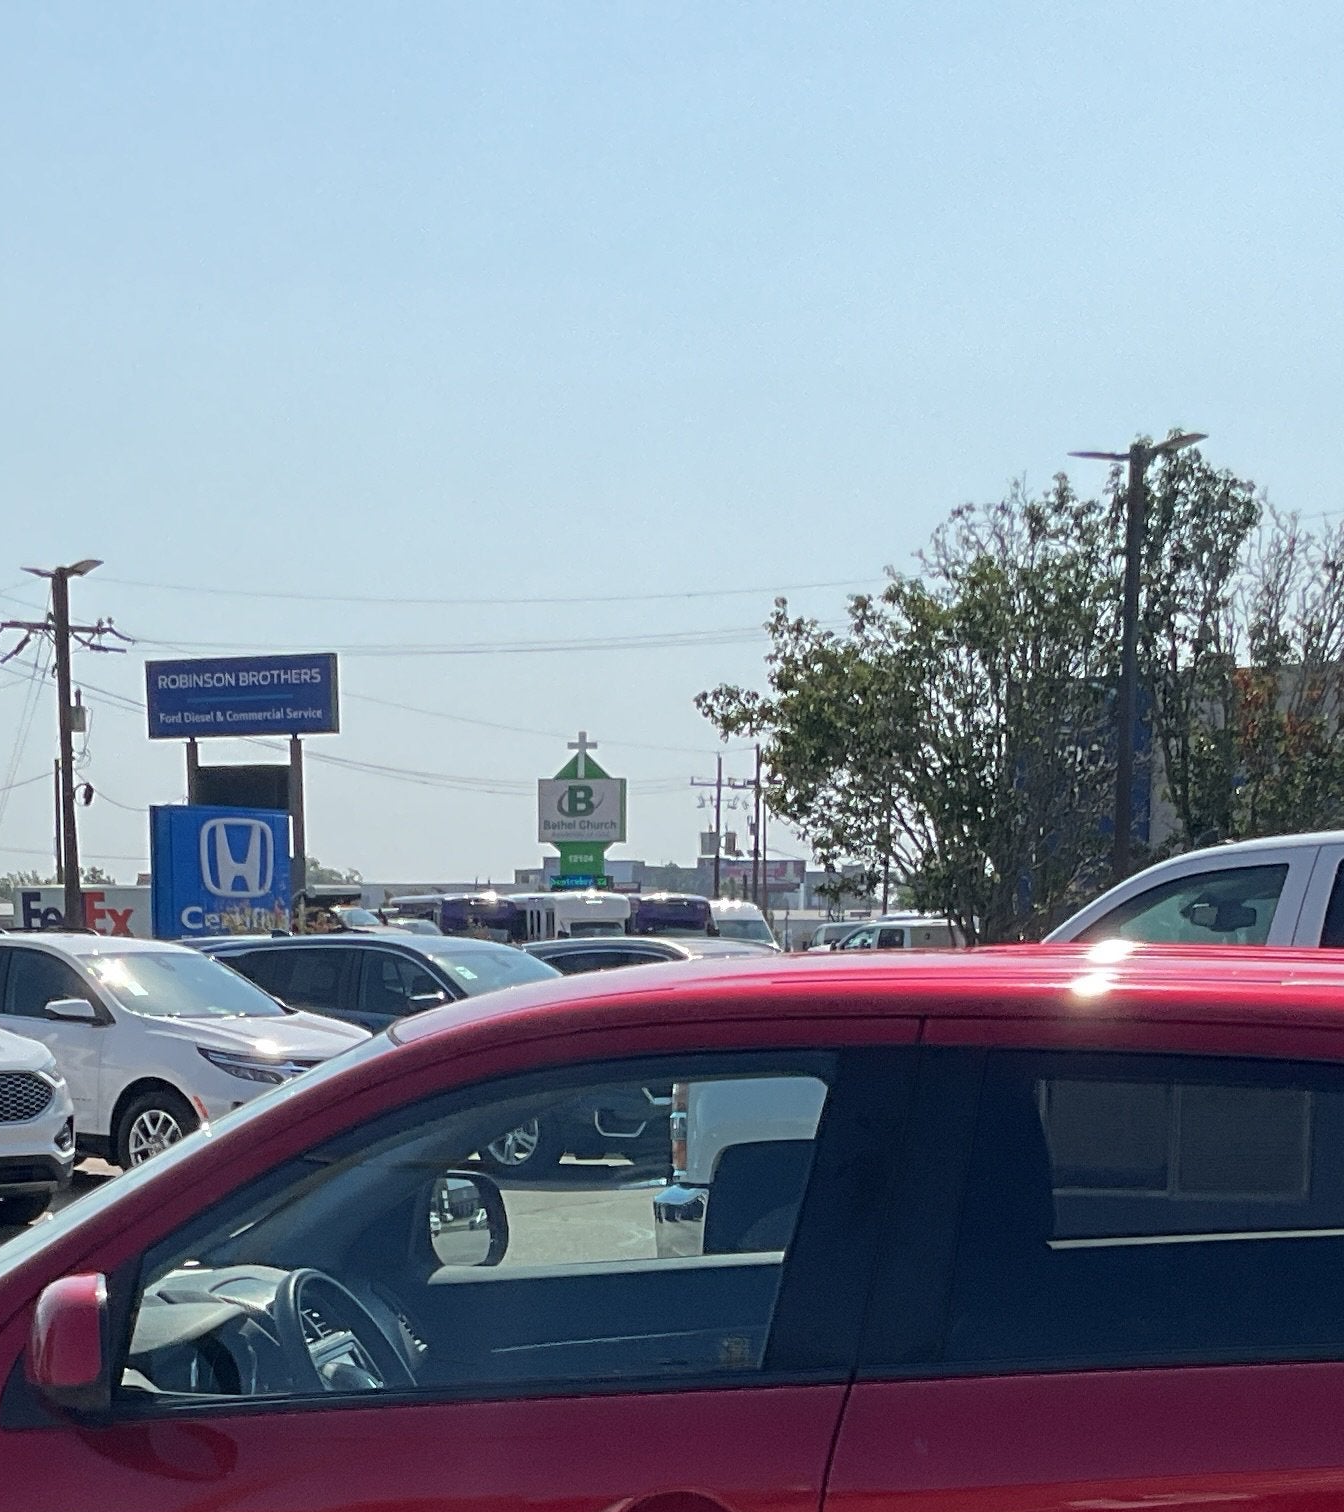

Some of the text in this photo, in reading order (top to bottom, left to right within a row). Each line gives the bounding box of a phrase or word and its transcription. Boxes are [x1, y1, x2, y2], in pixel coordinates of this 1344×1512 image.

[158, 668, 322, 689] ROBINSON BROTHERS
[159, 707, 323, 724] Ford Diesel & Commercial Service
[578, 819, 616, 831] Church
[21, 892, 135, 937] FeEx
